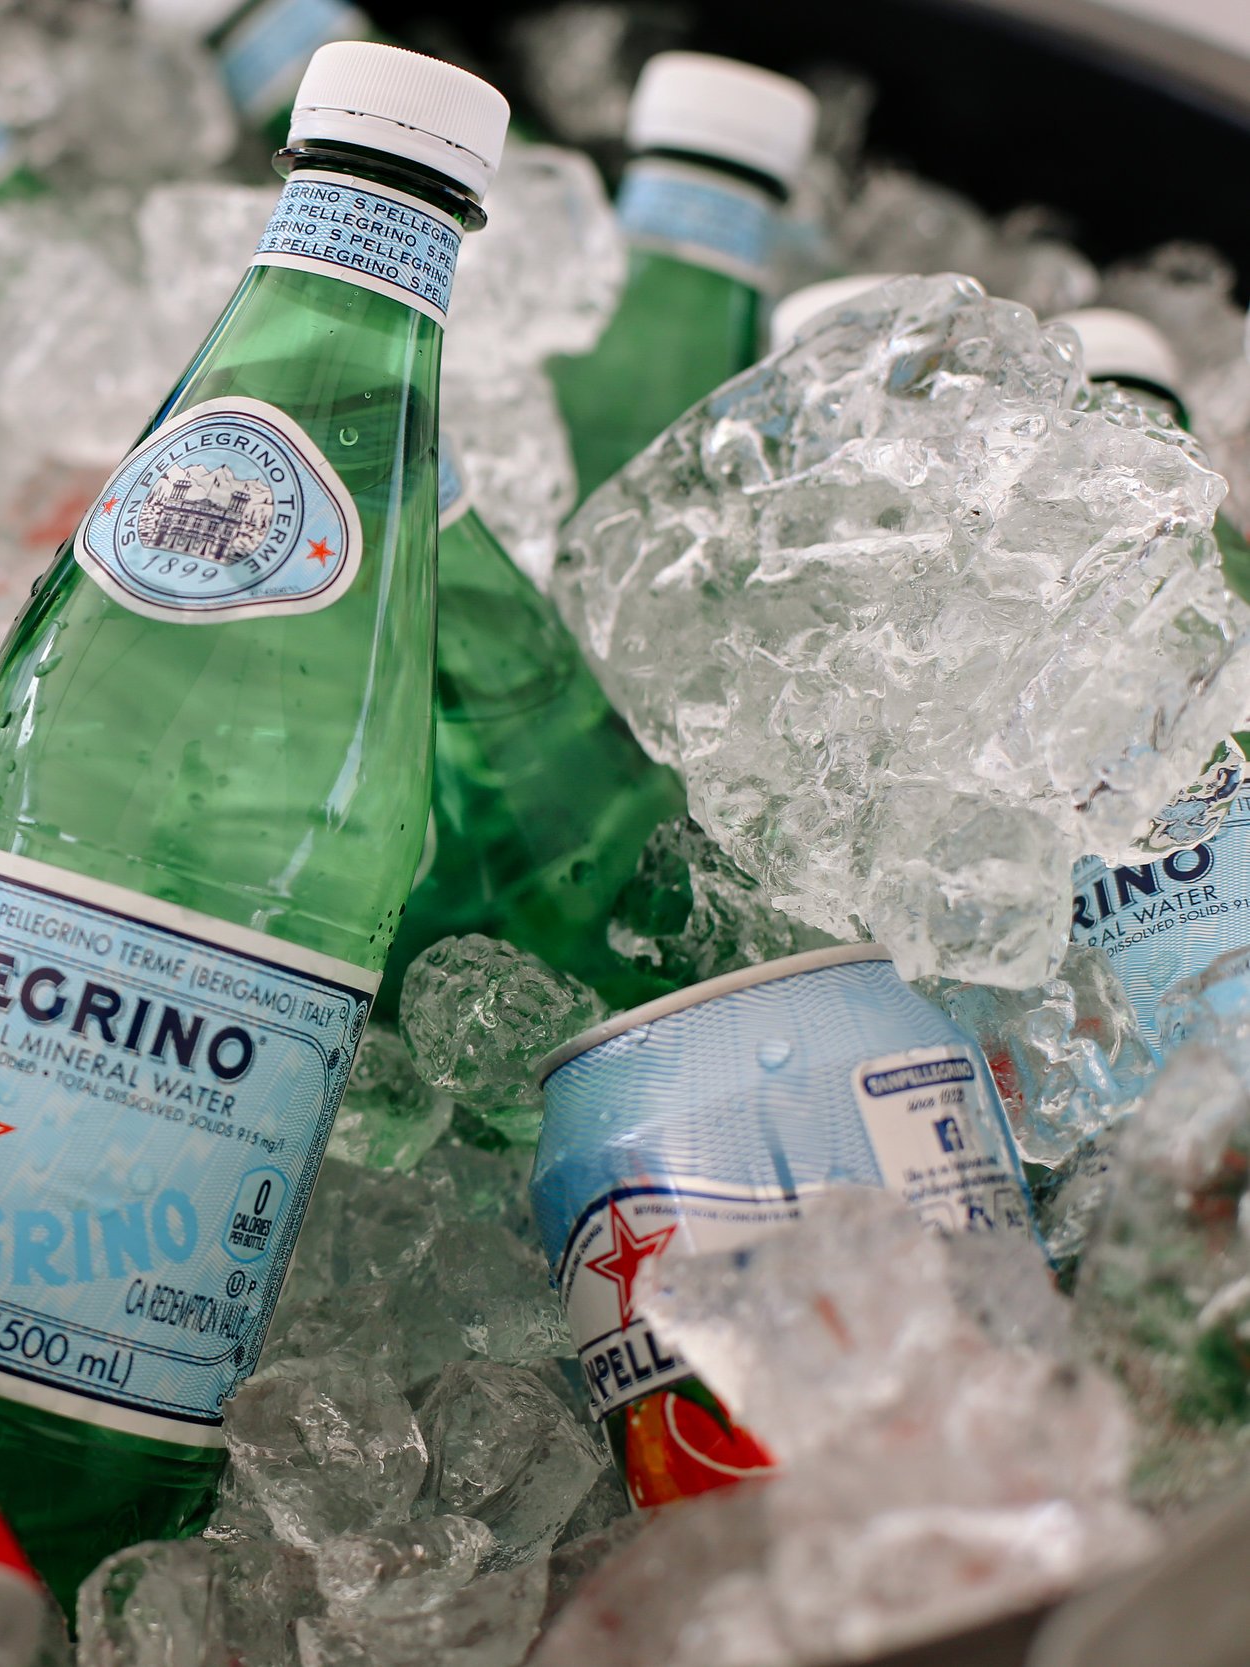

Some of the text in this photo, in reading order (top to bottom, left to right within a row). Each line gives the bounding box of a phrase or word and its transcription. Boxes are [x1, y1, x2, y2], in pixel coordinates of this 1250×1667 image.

[285, 203, 417, 247] S.PELLEGRINO
[269, 237, 398, 279] S.PELLEGRINO
[329, 228, 448, 287] S.PELLEGRINO
[122, 432, 295, 574] SAN PELLEGRINO TERME
[142, 554, 218, 584] 1899
[1133, 885, 1219, 925] WATER
[1106, 918, 1175, 958] DISSOLVED
[1179, 902, 1229, 925] SOLIDS
[118, 940, 185, 980] TERME
[189, 964, 298, 1019] (BERGAMO)
[299, 1004, 335, 1028] ITALY
[19, 1031, 138, 1088] MINERAL
[152, 1071, 237, 1118] WATER
[866, 1061, 973, 1093] SANPELLEGRINO
[55, 1069, 100, 1098] TOTAL
[104, 1086, 184, 1121] DISSOLVED
[188, 1111, 234, 1138] SOLIDS
[237, 1126, 259, 1146] 915
[254, 1179, 271, 1216] 0
[228, 1231, 268, 1252] PER BOTTLE
[233, 1212, 273, 1238] CALORIES
[125, 1278, 148, 1317] CA
[77, 1350, 134, 1389] mL)
